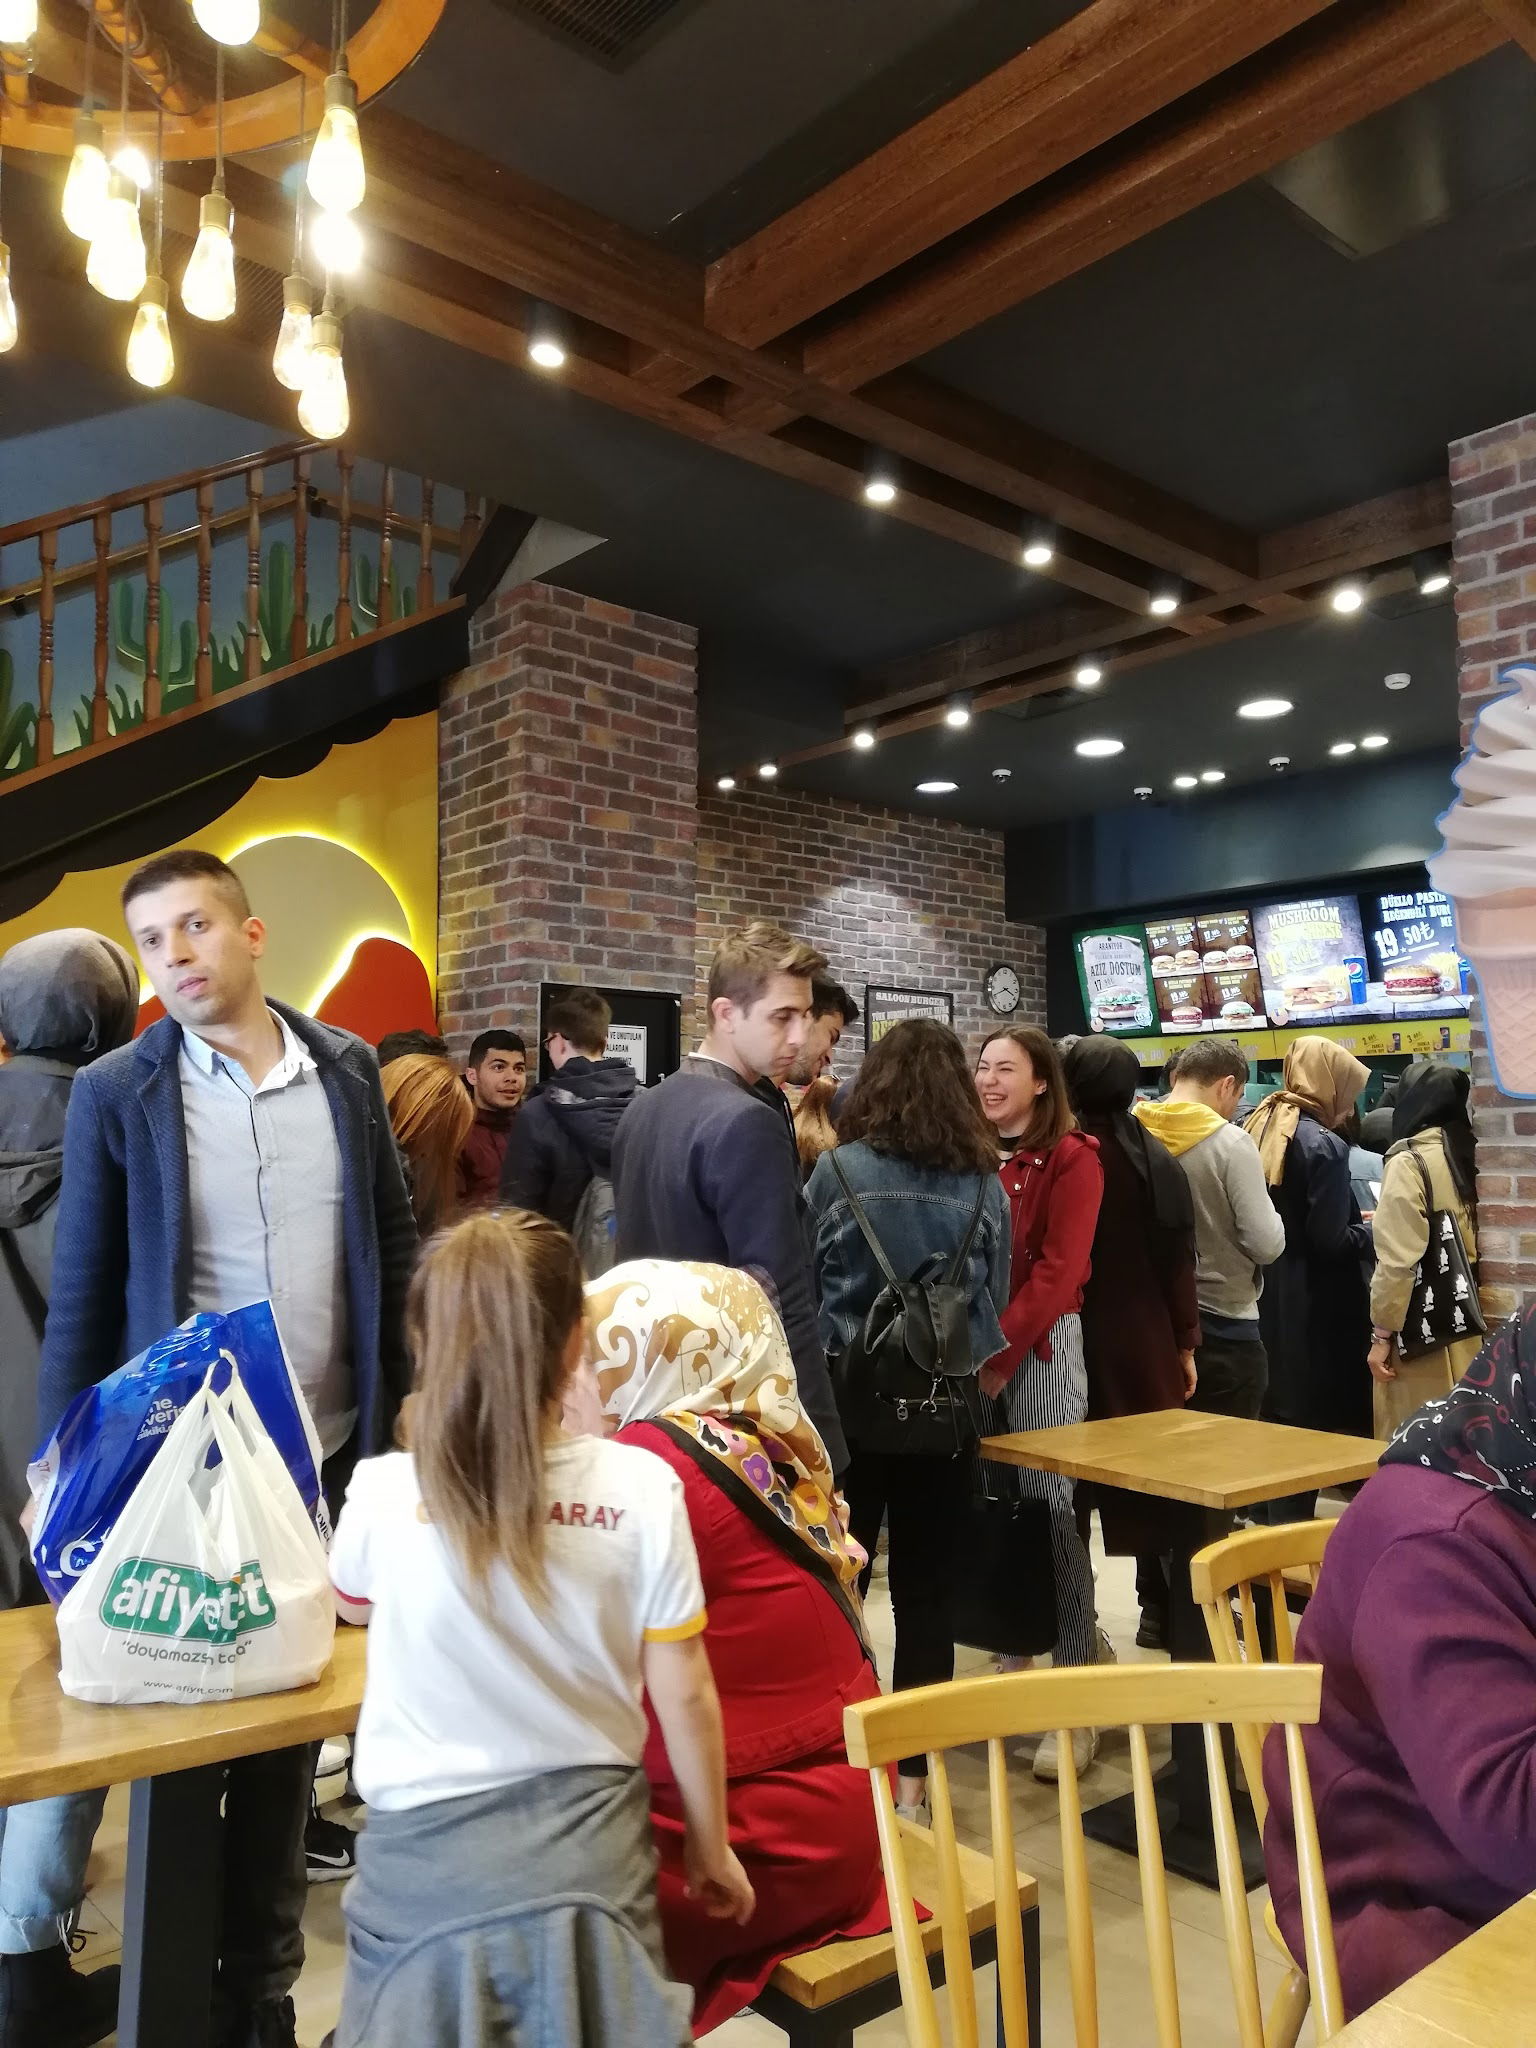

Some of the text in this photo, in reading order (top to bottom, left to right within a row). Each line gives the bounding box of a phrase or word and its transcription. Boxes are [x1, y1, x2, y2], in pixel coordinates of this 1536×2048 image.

[1267, 906, 1341, 930] MUSHROOM
[1375, 928, 1399, 959] 19
[1110, 961, 1142, 976] DOSTUM
[875, 992, 945, 1007] SALOON BURGER
[617, 1032, 642, 1041] UNUTULAN
